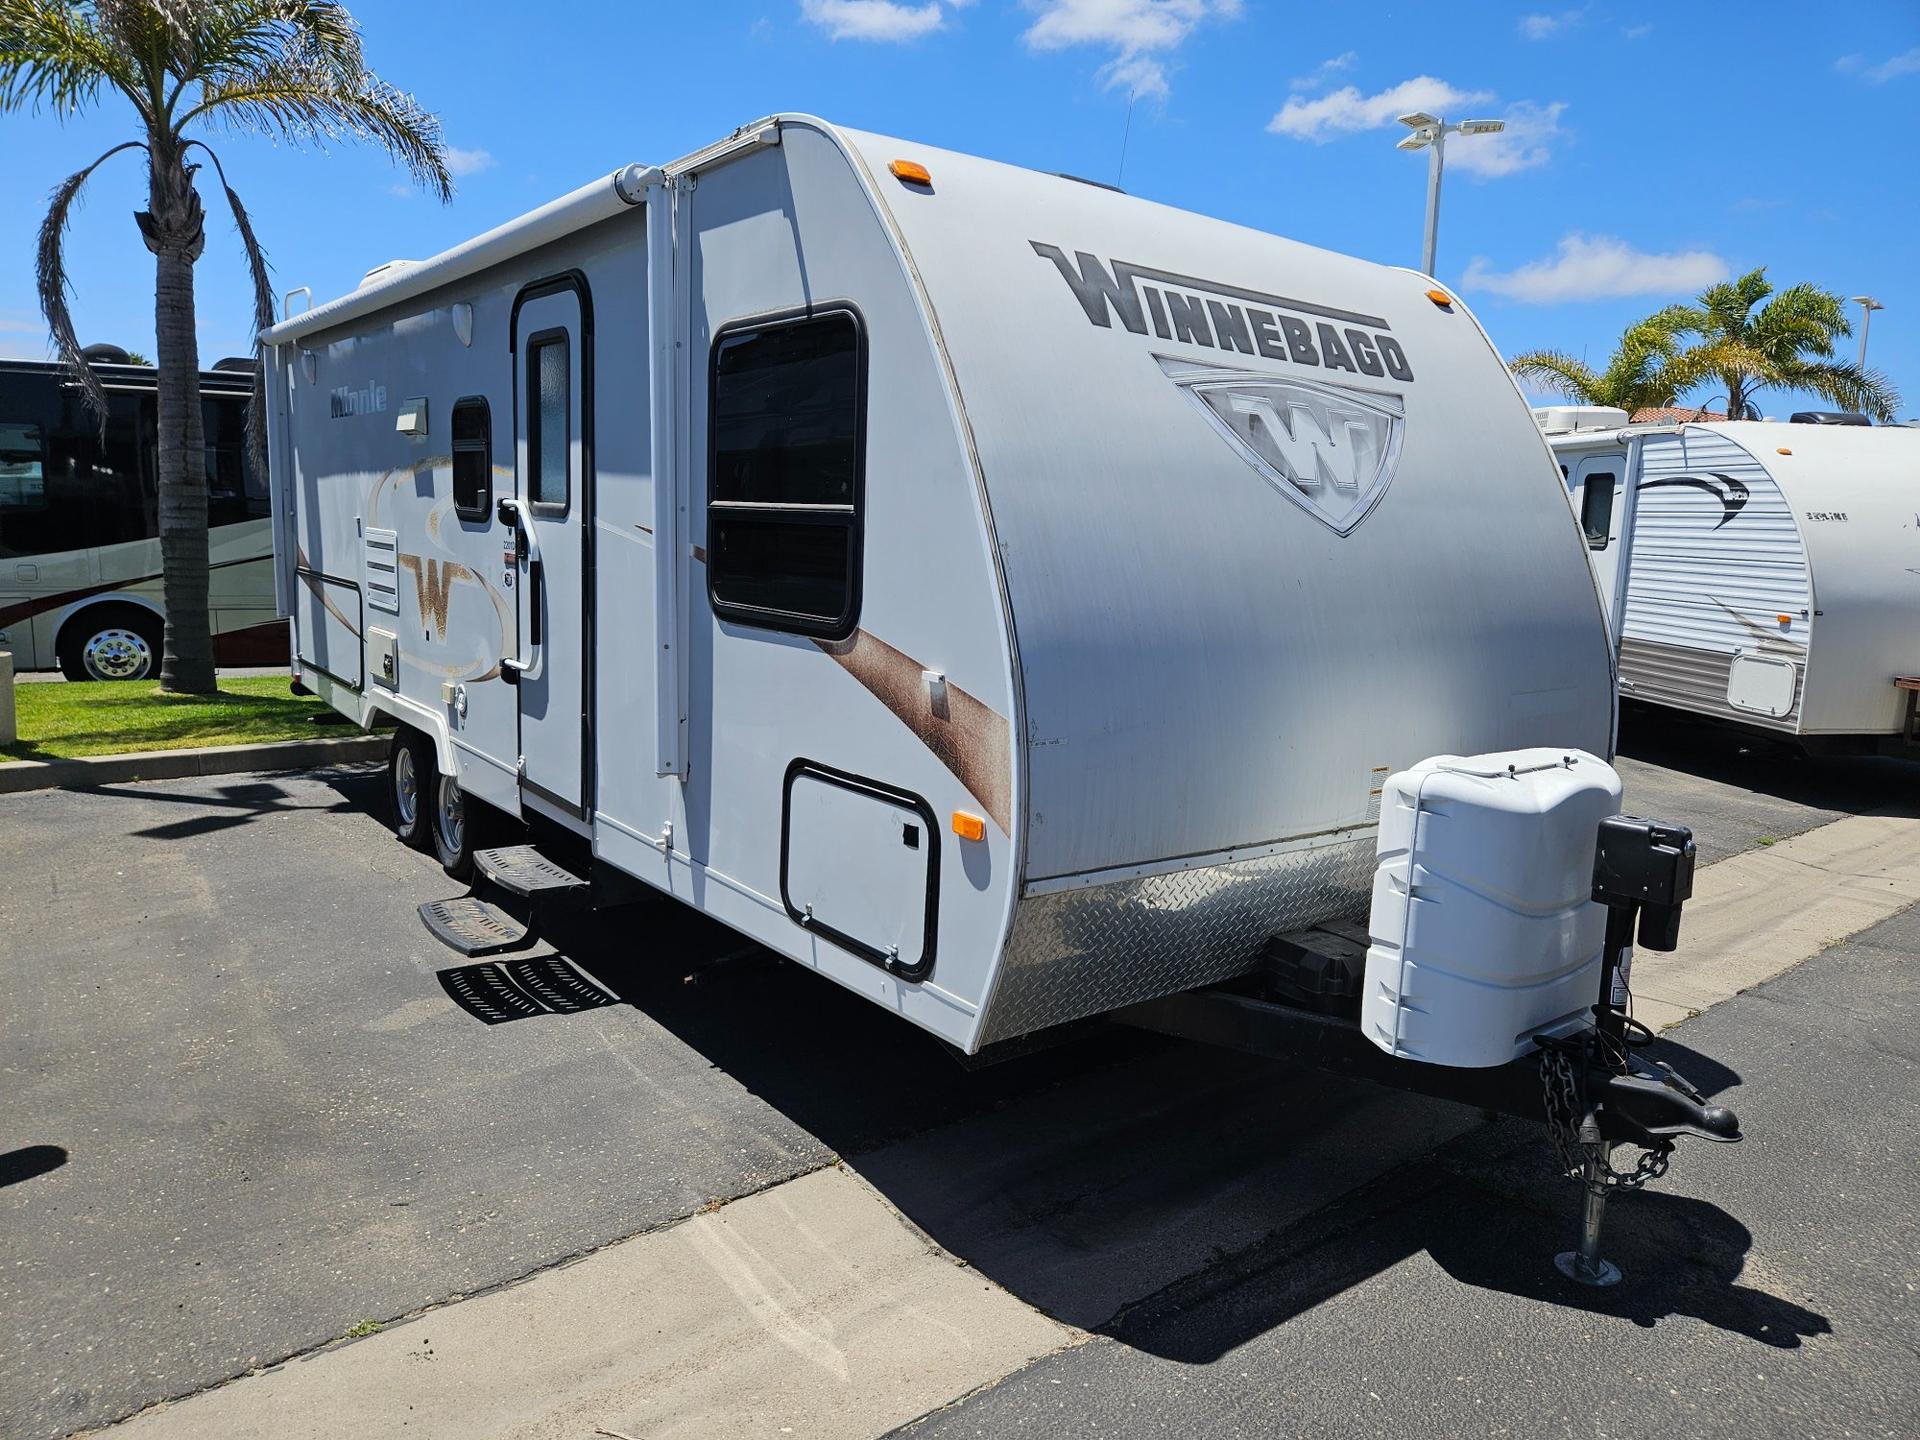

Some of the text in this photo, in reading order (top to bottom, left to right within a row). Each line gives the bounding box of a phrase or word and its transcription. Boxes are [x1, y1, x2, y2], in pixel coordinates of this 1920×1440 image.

[1028, 240, 1415, 382] WINNEBAGO
[330, 379, 387, 418] Minnie
[1227, 392, 1369, 489] W
